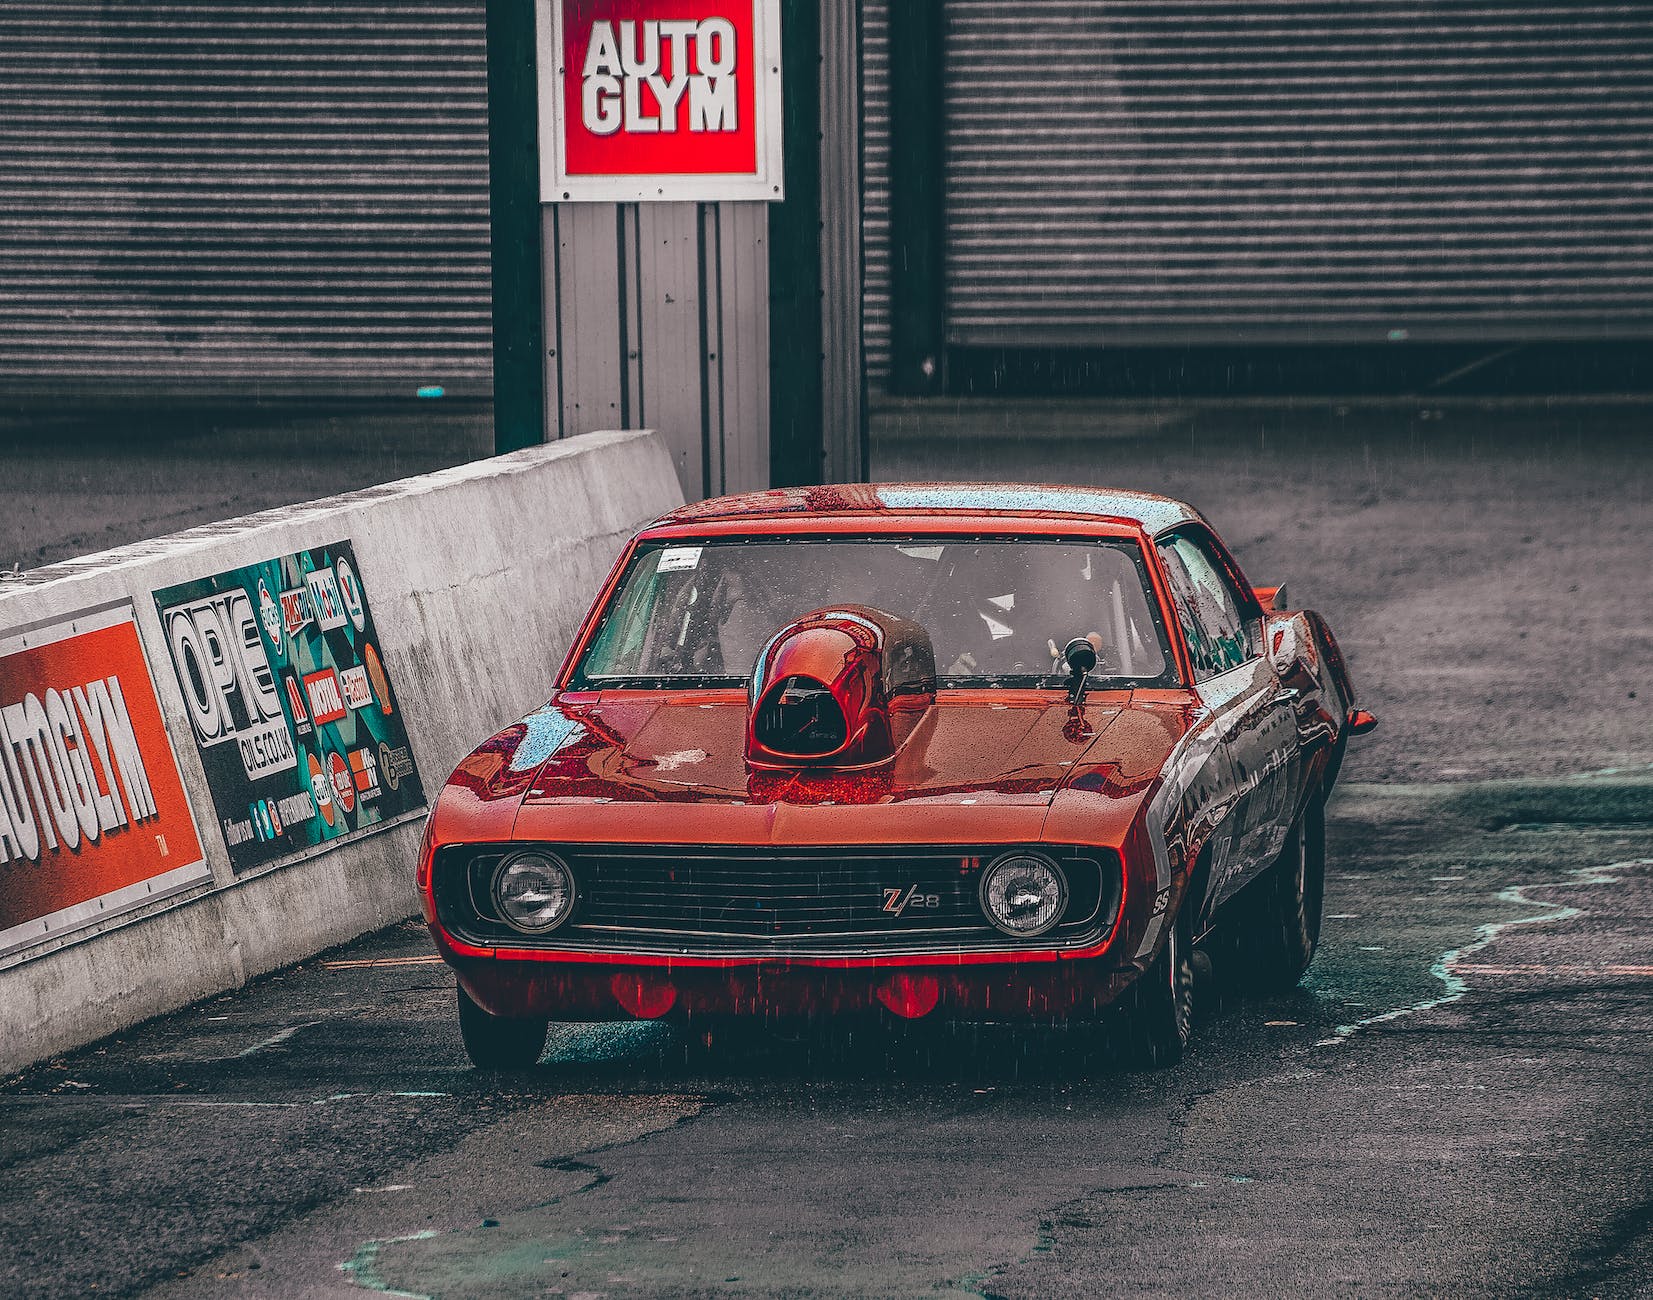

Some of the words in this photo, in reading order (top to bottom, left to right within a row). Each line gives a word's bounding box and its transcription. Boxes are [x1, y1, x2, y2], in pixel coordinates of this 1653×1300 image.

[582, 16, 737, 77] AUTO
[582, 73, 738, 135] GLYM
[281, 591, 313, 628] AMSOIL
[310, 577, 344, 621] Mobil
[168, 596, 283, 739] OPIE
[346, 669, 371, 703] Castrol
[307, 676, 343, 717] MOTUL
[241, 726, 294, 772] OILS.CO.UK
[314, 778, 330, 802] Gulf
[883, 883, 940, 917] Z/28
[1153, 890, 1169, 914] SS
